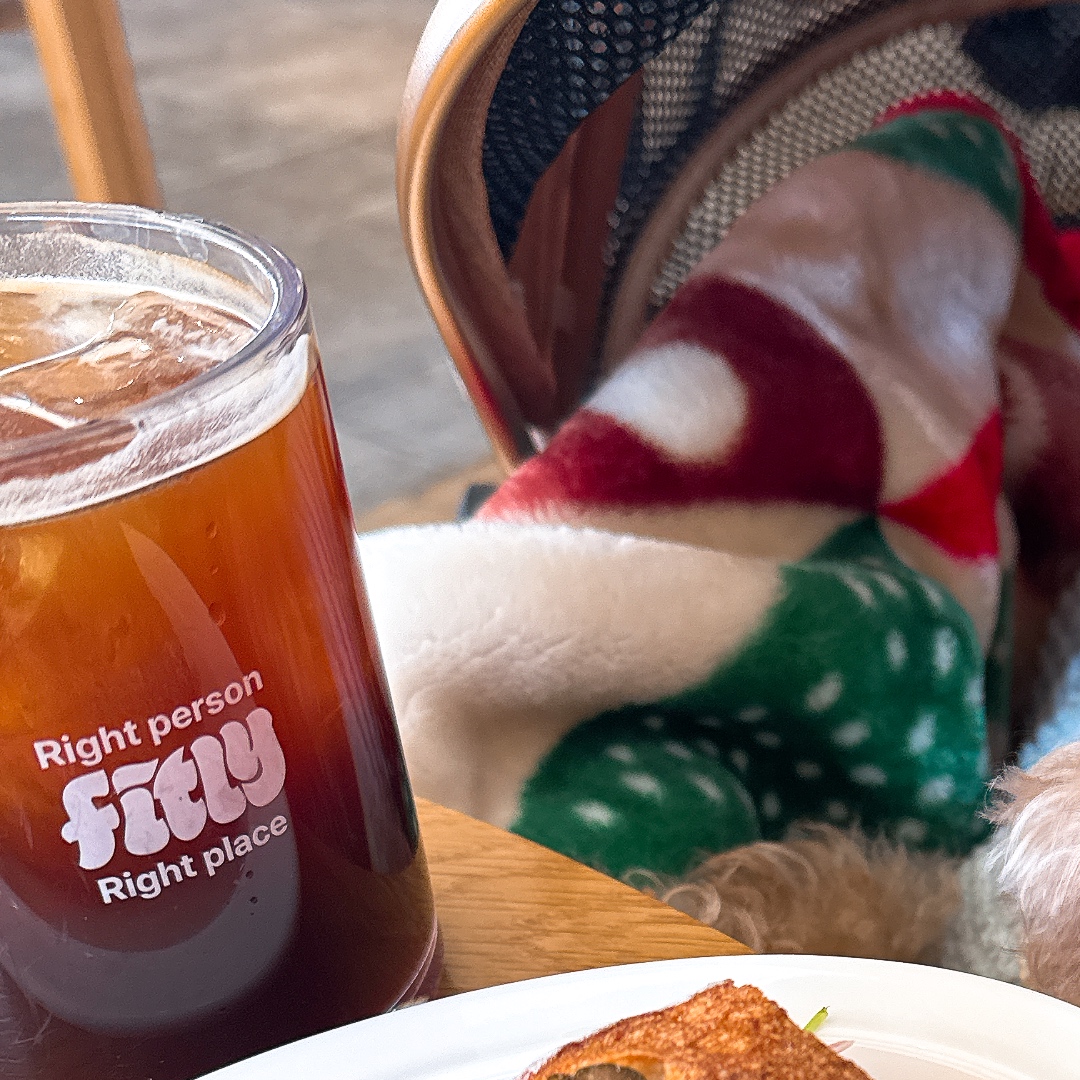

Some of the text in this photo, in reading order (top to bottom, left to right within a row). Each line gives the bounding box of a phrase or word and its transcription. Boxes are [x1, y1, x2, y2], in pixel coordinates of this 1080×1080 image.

[33, 670, 264, 770] Right person
[97, 815, 288, 904] Right place
